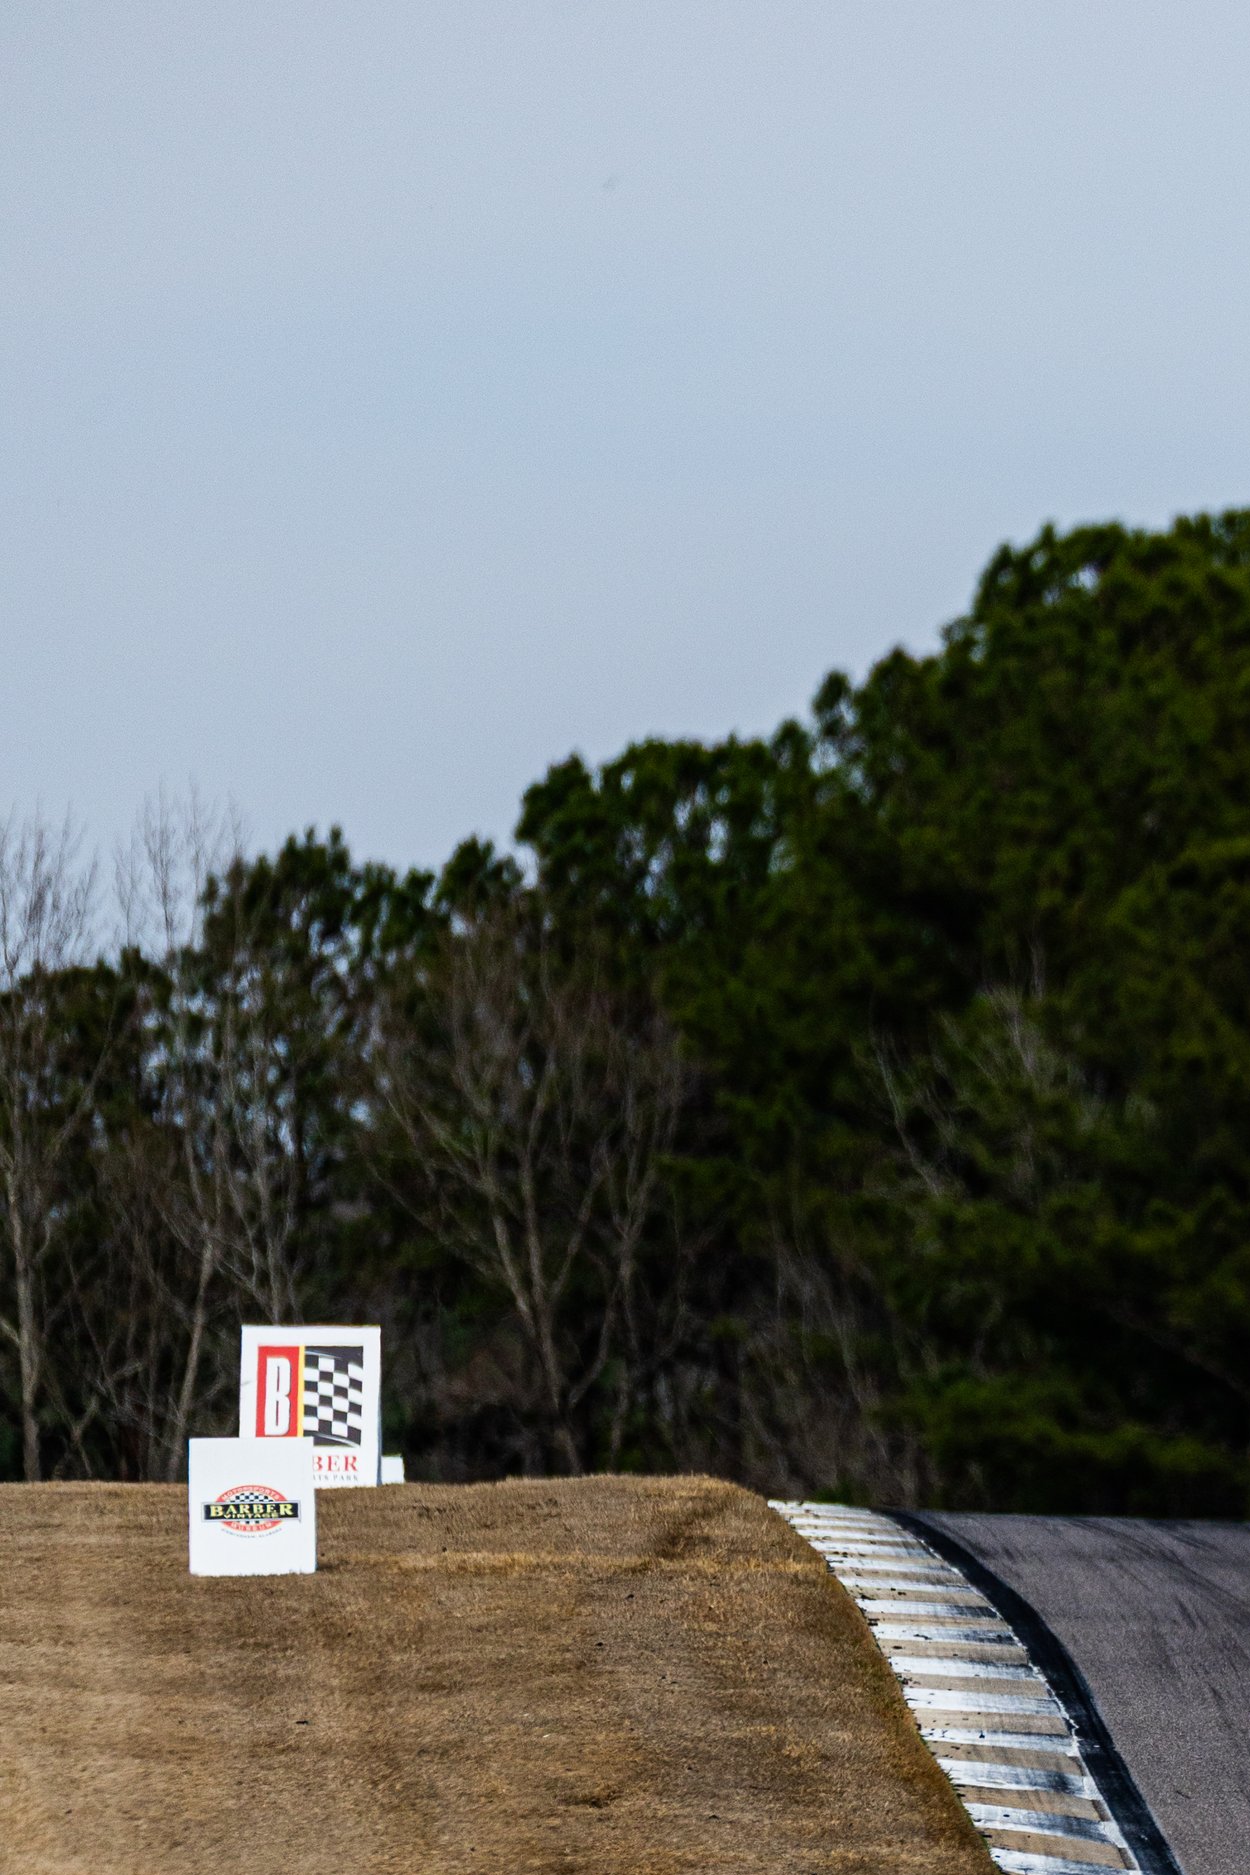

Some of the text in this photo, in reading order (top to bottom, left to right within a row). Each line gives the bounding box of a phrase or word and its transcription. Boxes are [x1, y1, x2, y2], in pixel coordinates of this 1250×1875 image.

[264, 1357, 291, 1436] B
[312, 1455, 357, 1471] BER
[210, 1503, 293, 1517] BARBER
